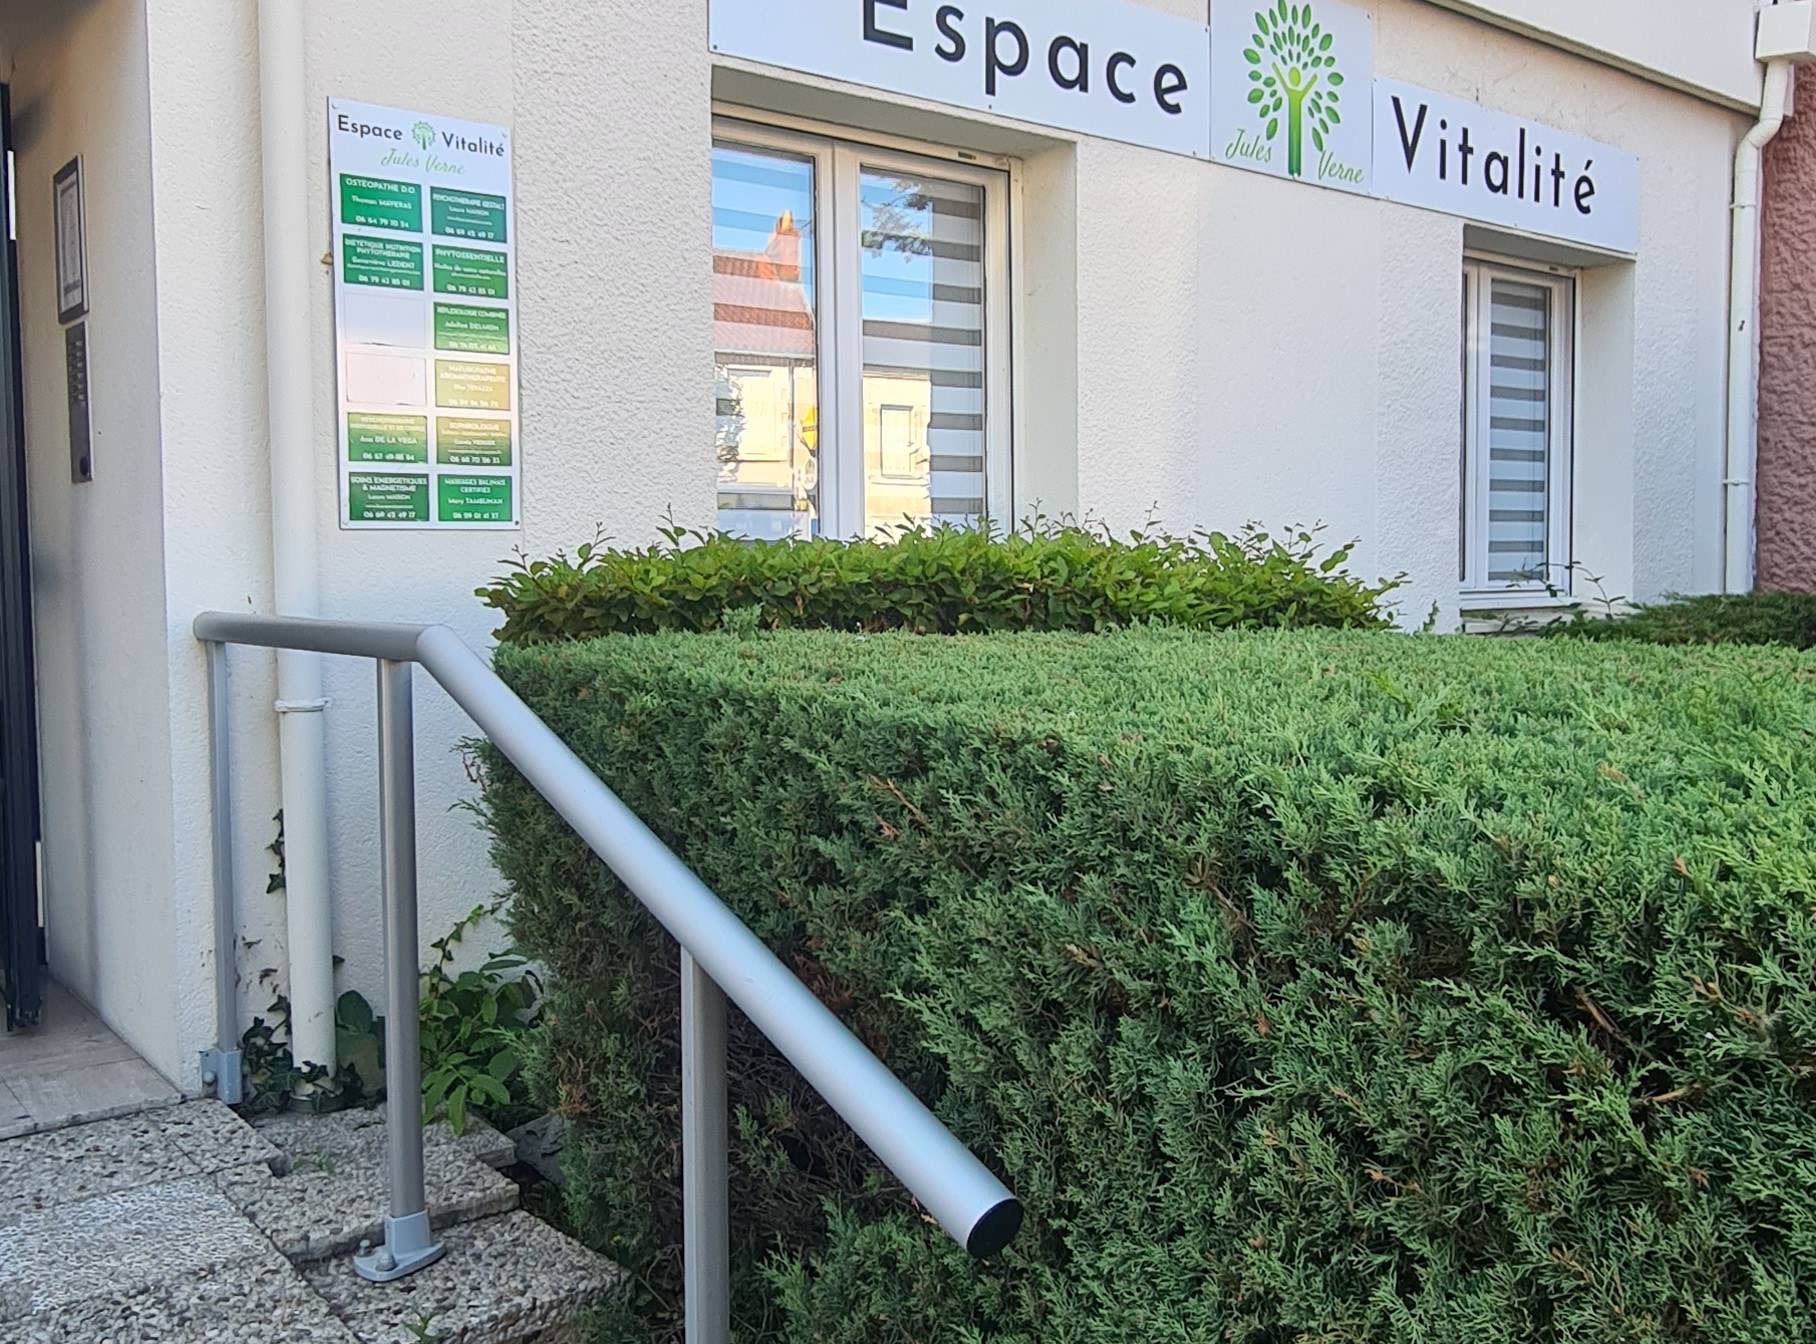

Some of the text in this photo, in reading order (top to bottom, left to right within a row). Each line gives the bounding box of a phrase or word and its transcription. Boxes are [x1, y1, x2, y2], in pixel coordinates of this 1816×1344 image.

[338, 114, 505, 157] Espace Vitalité
[1225, 128, 1365, 184] Jules Verne
[1391, 96, 1596, 217] Vitalité
[381, 147, 466, 174] Jules Verne
